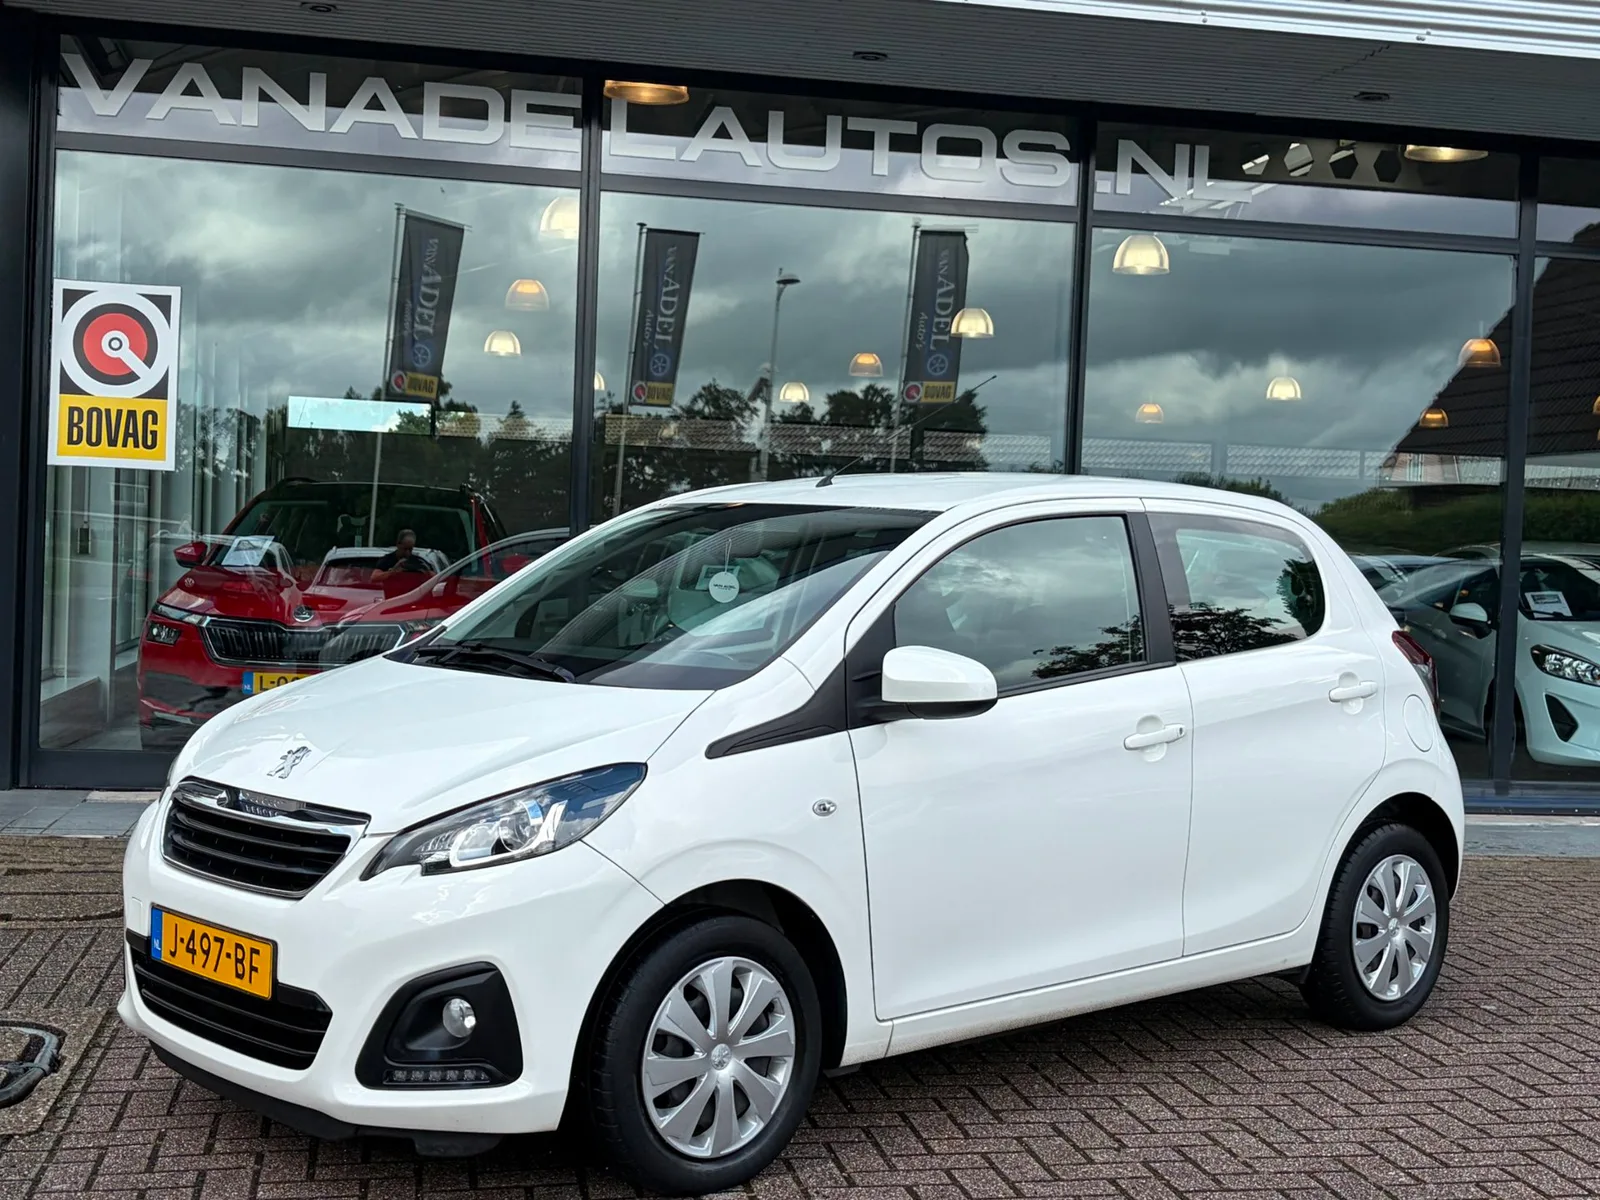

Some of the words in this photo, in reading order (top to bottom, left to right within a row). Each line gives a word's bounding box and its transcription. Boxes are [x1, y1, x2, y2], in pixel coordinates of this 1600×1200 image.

[67, 406, 158, 450] BOVAG
[153, 937, 162, 951] NL
[169, 922, 261, 985] J-497-BF
